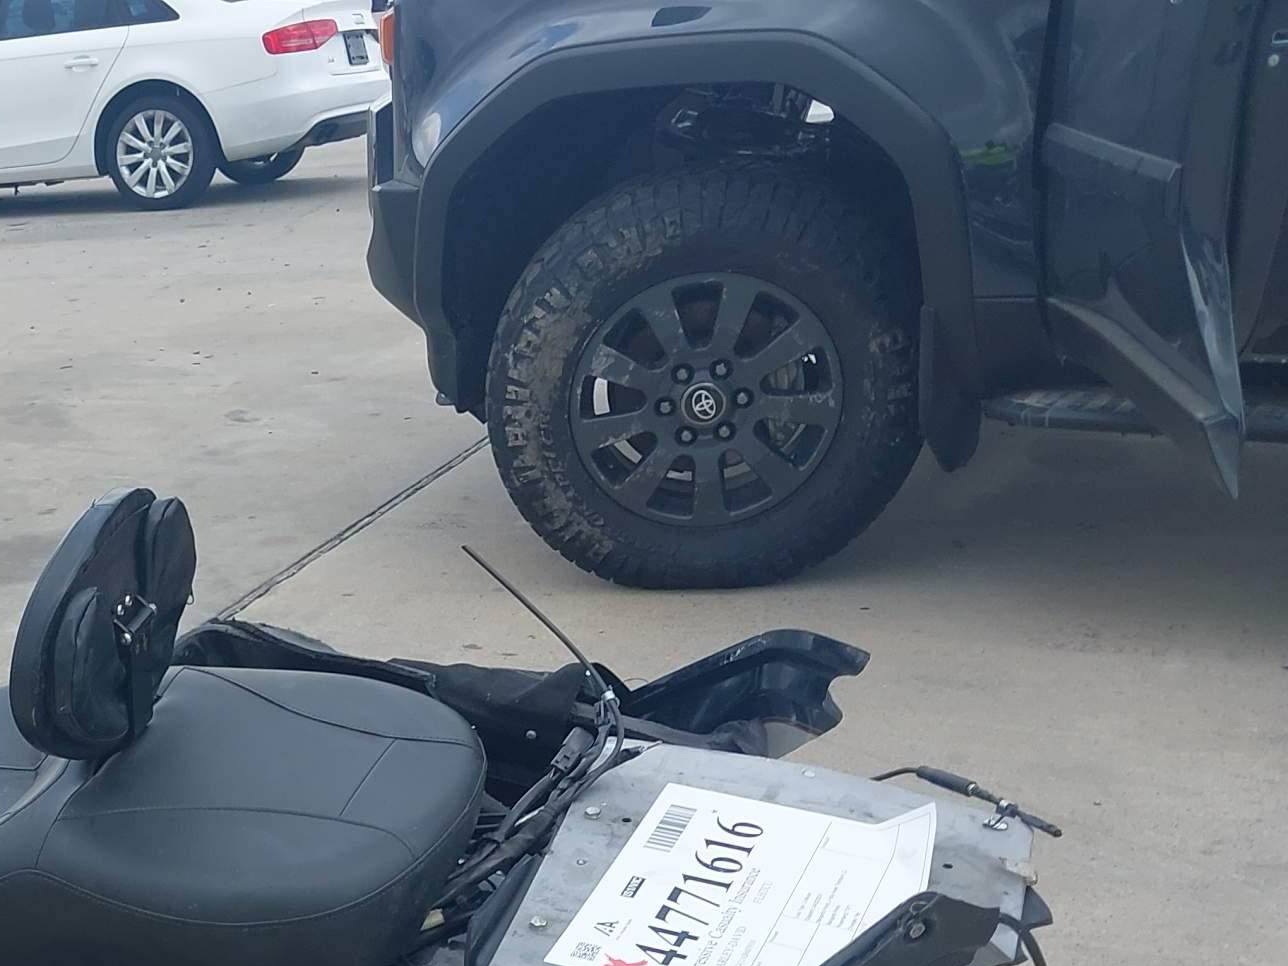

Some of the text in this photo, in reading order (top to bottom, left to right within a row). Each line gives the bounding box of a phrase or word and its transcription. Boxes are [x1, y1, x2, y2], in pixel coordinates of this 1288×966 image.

[635, 815, 764, 966] 44771616
[707, 905, 742, 940] Casualty
[728, 867, 761, 905] Insurance
